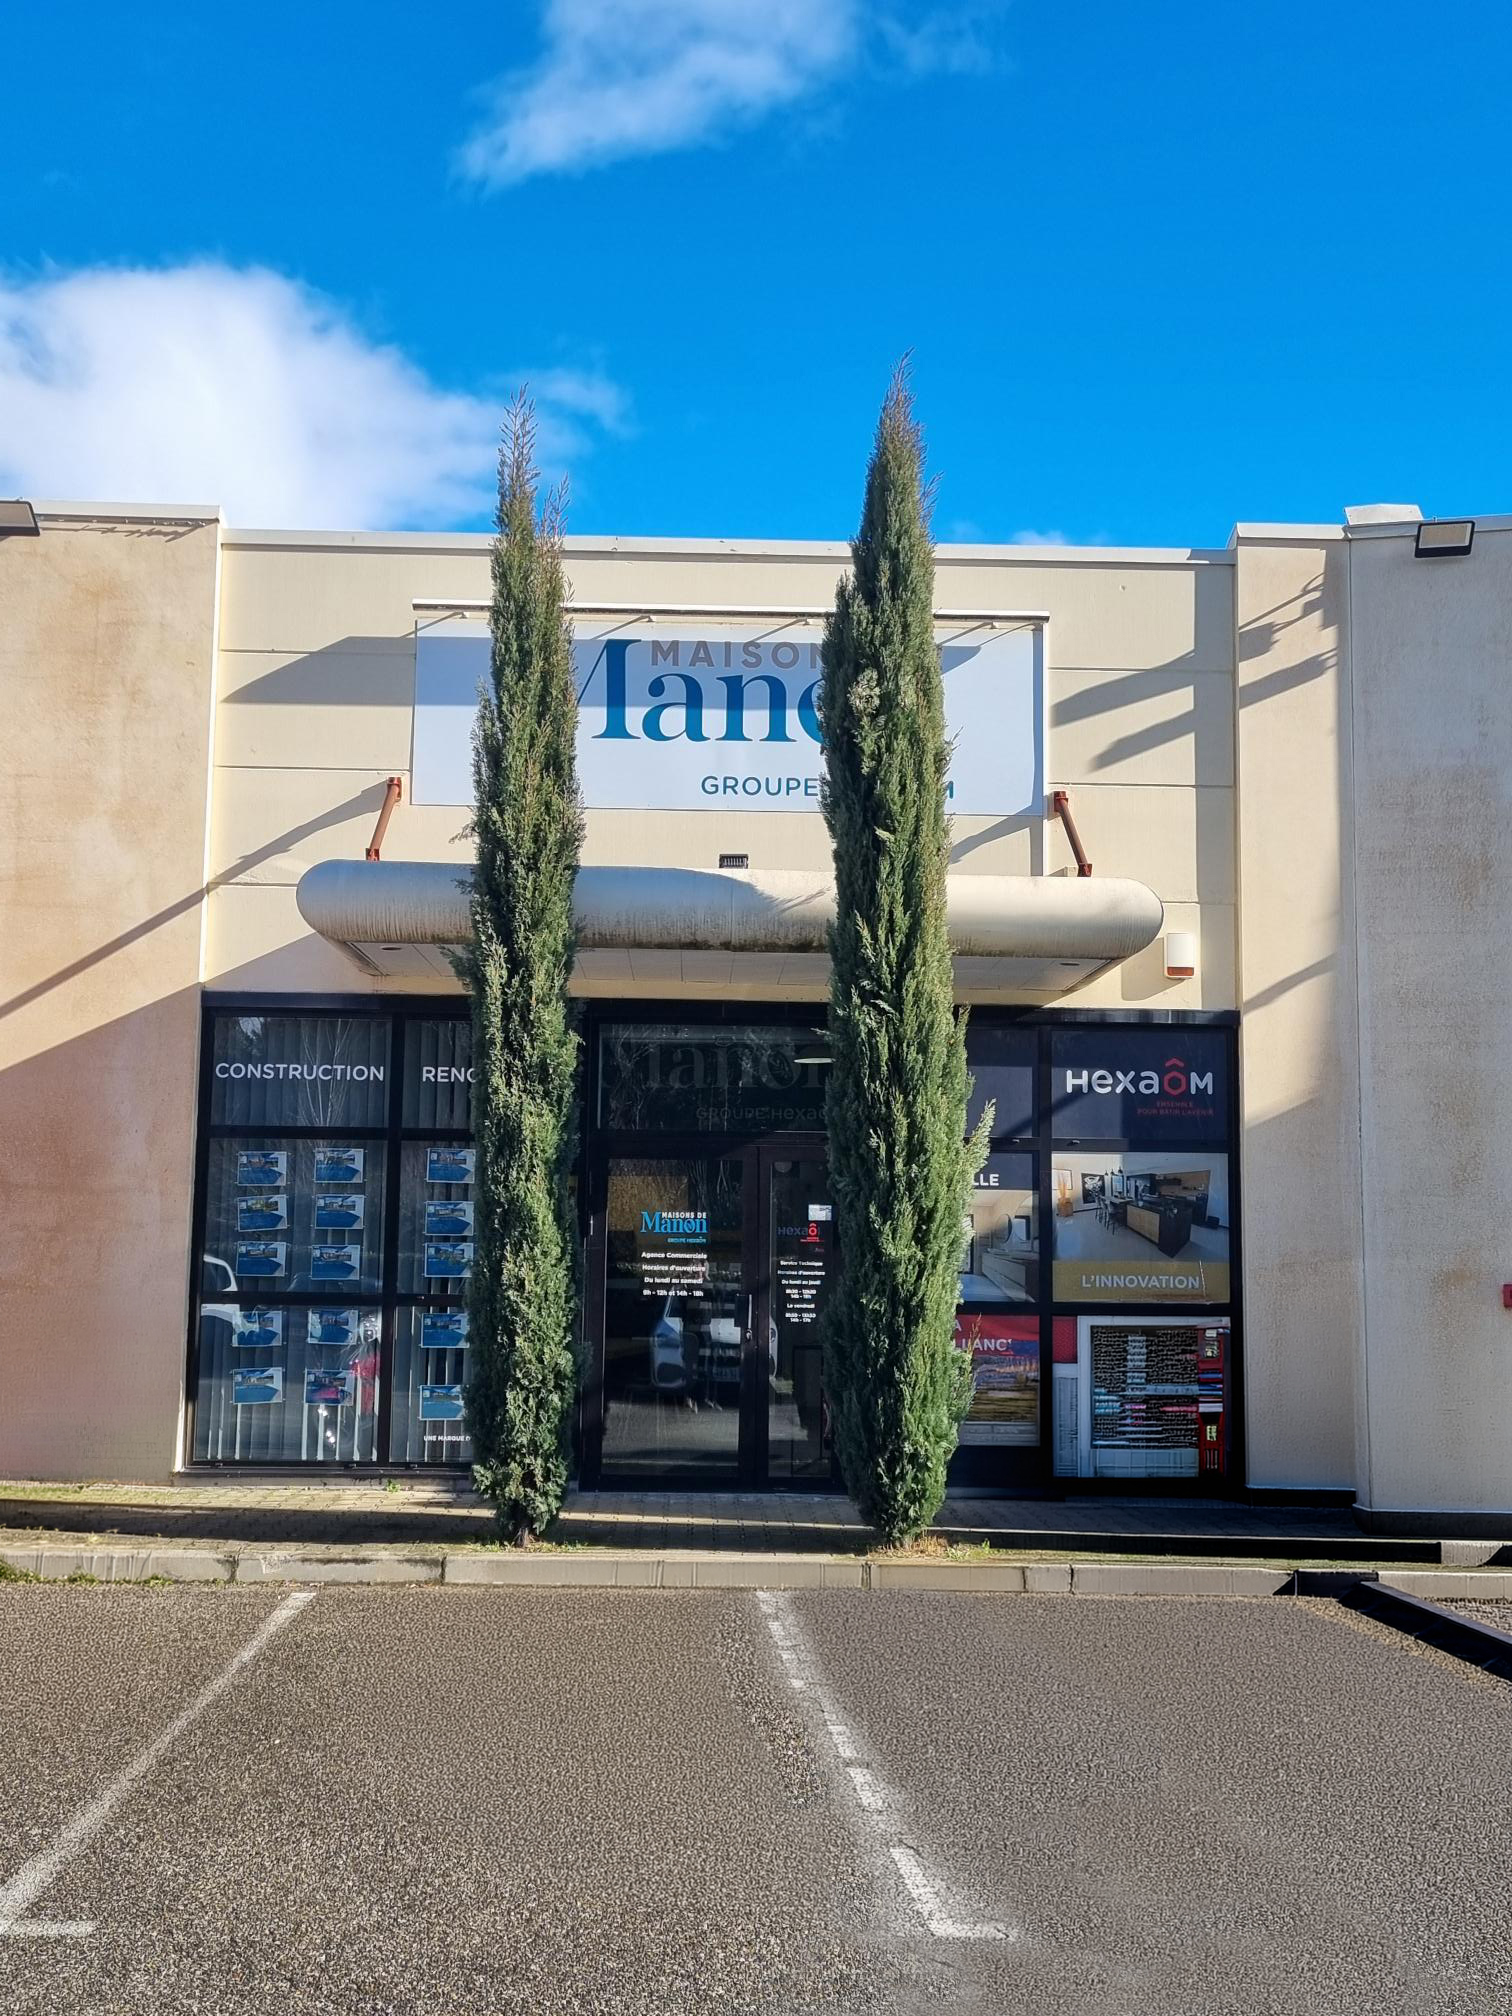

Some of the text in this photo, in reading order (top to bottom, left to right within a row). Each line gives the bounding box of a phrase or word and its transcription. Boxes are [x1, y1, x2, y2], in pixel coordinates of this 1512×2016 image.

[701, 776, 819, 797] GROUPE
[215, 1062, 385, 1081] CONSTRUCTION
[662, 1211, 707, 1219] MAISONS DE
[640, 1211, 708, 1234] Manon
[641, 1251, 666, 1259] Agence
[669, 1264, 706, 1272] d'ouverture
